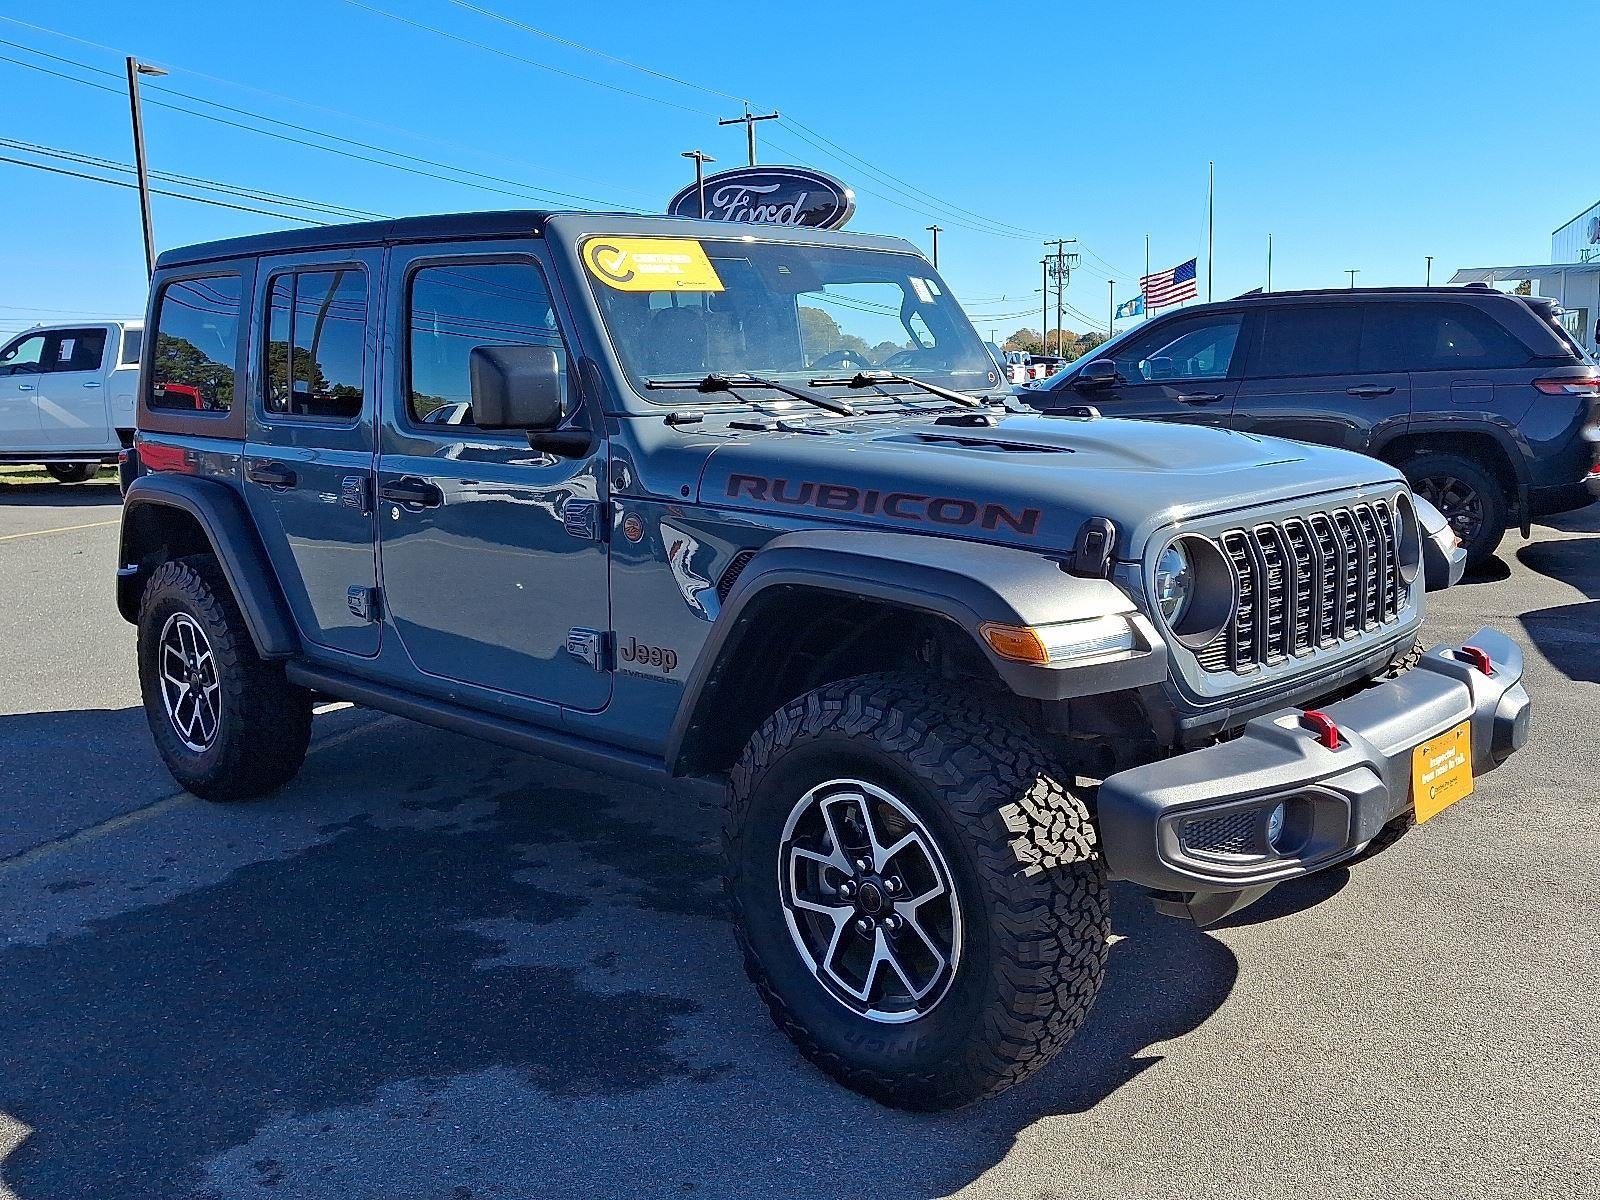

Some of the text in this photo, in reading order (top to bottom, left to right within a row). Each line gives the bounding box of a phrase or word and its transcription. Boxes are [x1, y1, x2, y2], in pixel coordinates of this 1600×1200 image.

[707, 184, 807, 226] Ford
[726, 473, 1041, 536] RUBICON
[620, 636, 678, 673] Jeep
